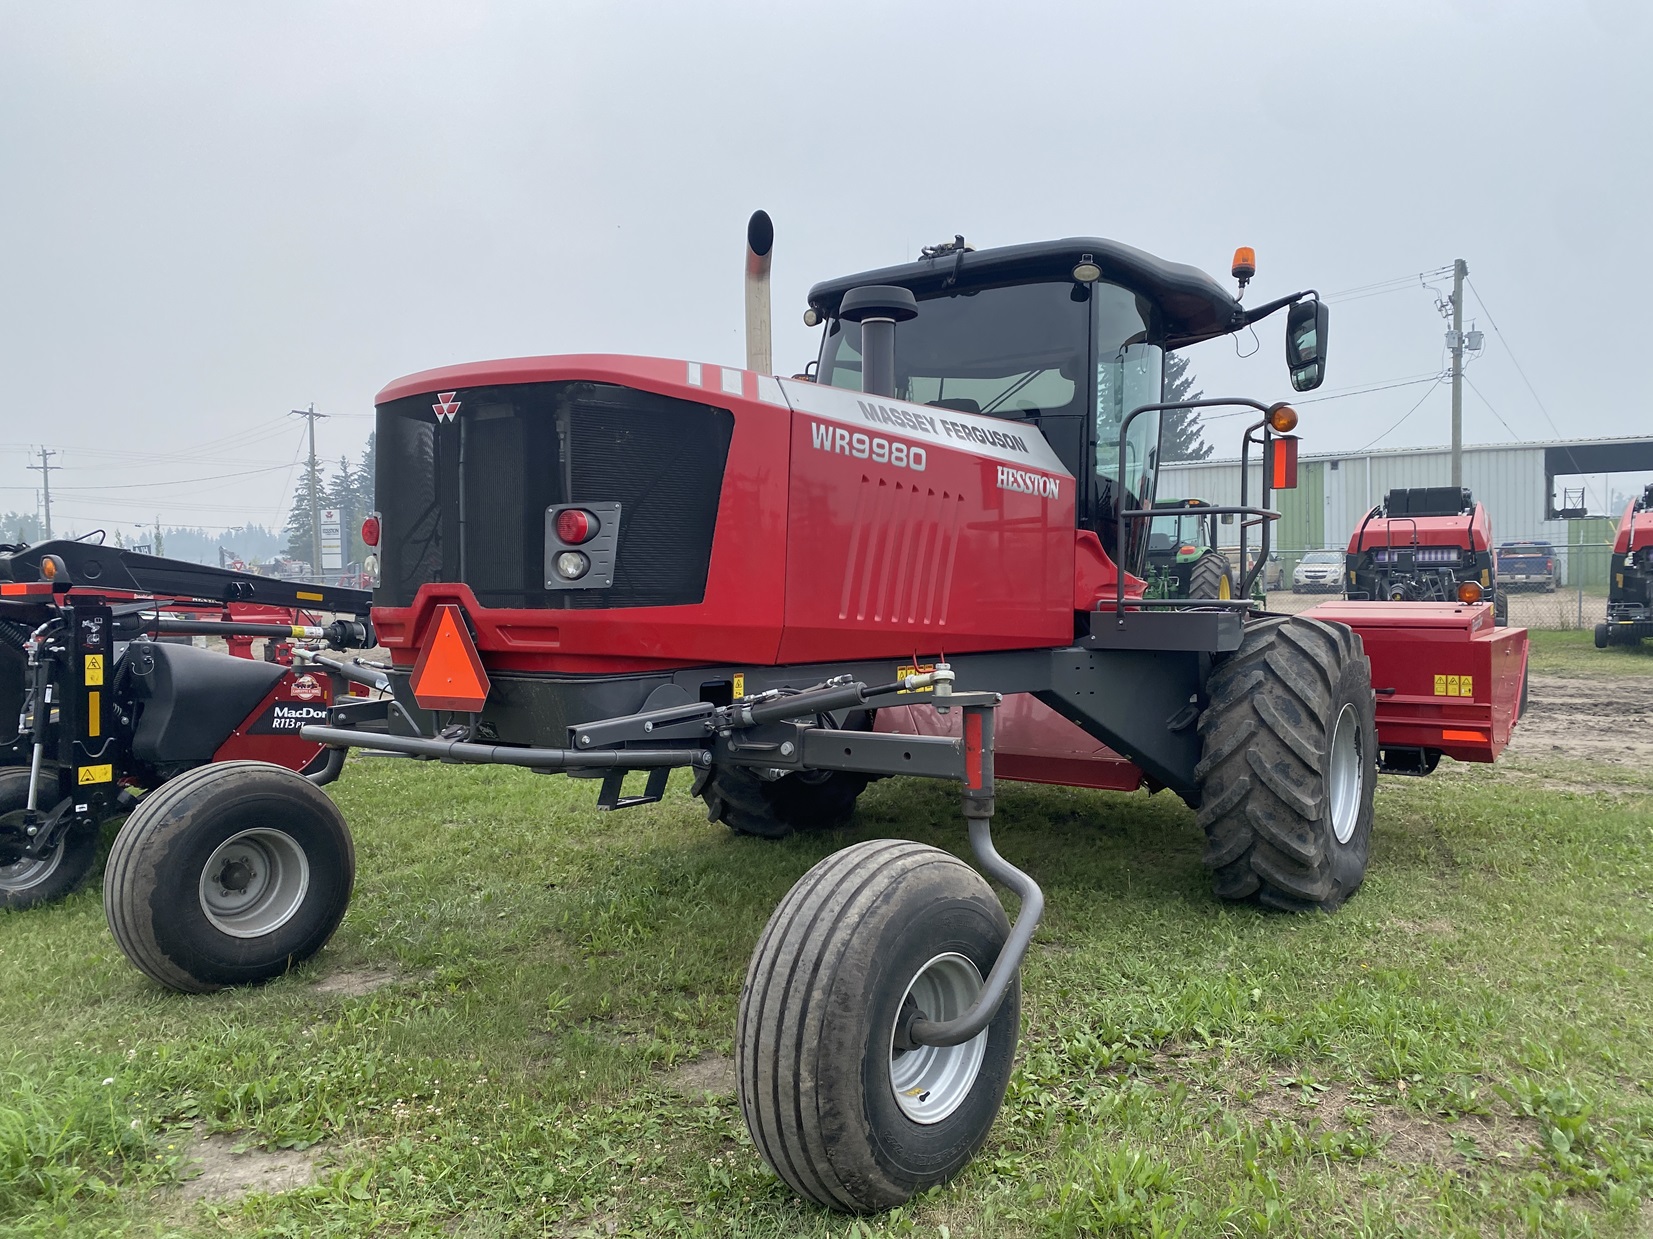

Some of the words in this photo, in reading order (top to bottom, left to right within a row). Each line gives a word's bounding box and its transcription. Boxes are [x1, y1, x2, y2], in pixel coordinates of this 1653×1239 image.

[811, 422, 927, 472] WR9980
[857, 400, 940, 435] MASSEY
[940, 419, 1030, 453] FERGUSON
[996, 466, 1060, 500] HESSTON
[272, 718, 296, 729] R113
